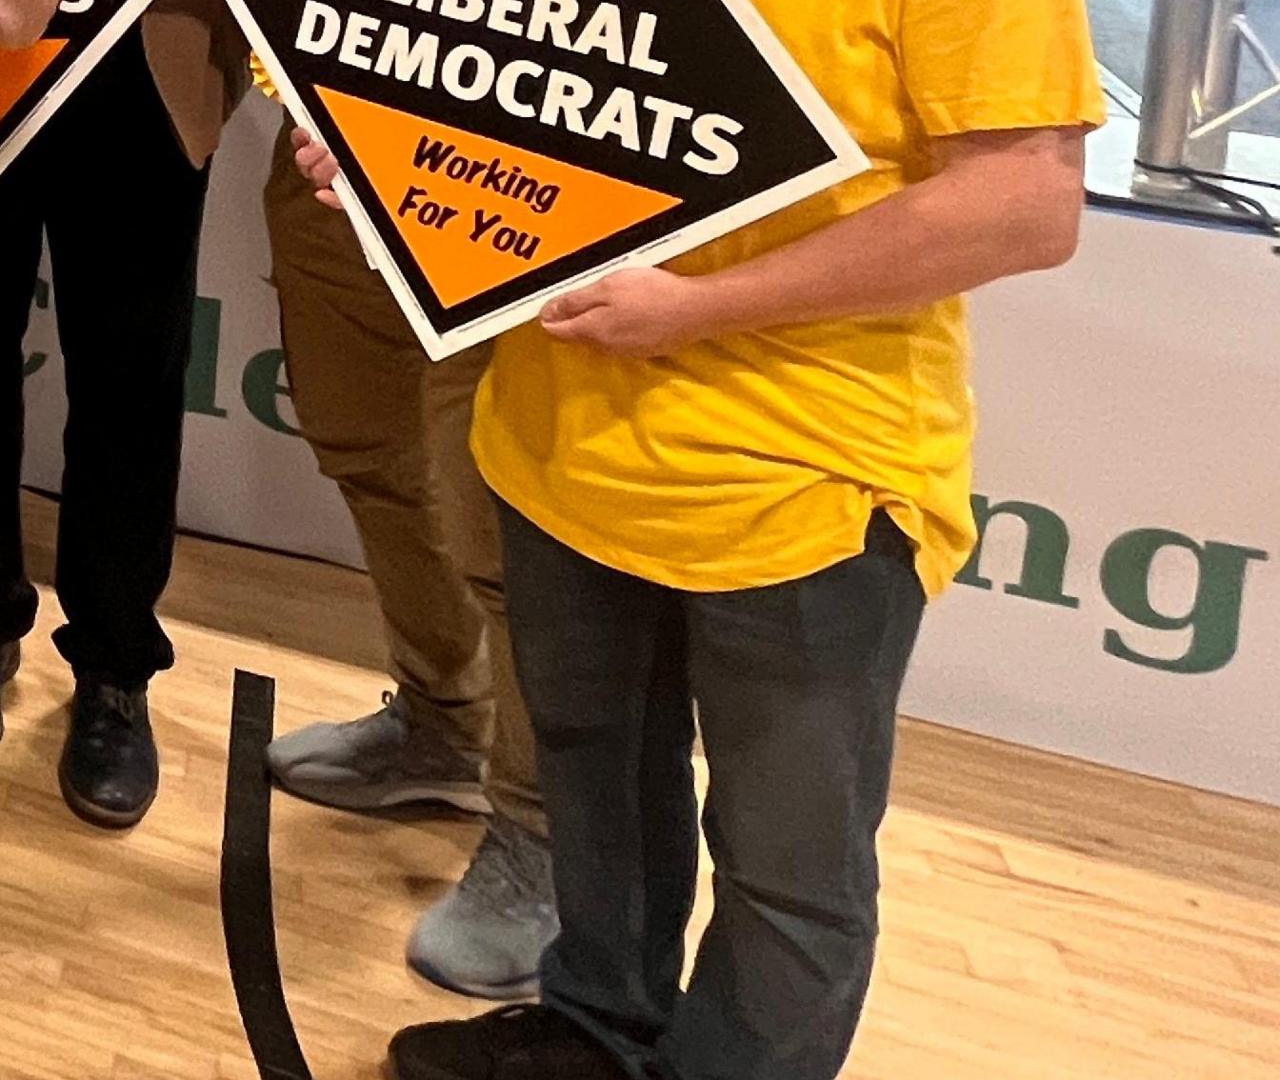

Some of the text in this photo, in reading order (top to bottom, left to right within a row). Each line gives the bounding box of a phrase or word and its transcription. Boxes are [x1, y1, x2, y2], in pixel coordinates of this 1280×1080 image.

[294, 0, 745, 177] DEMOCRATS
[413, 134, 560, 214] Working
[398, 185, 542, 261] For You
